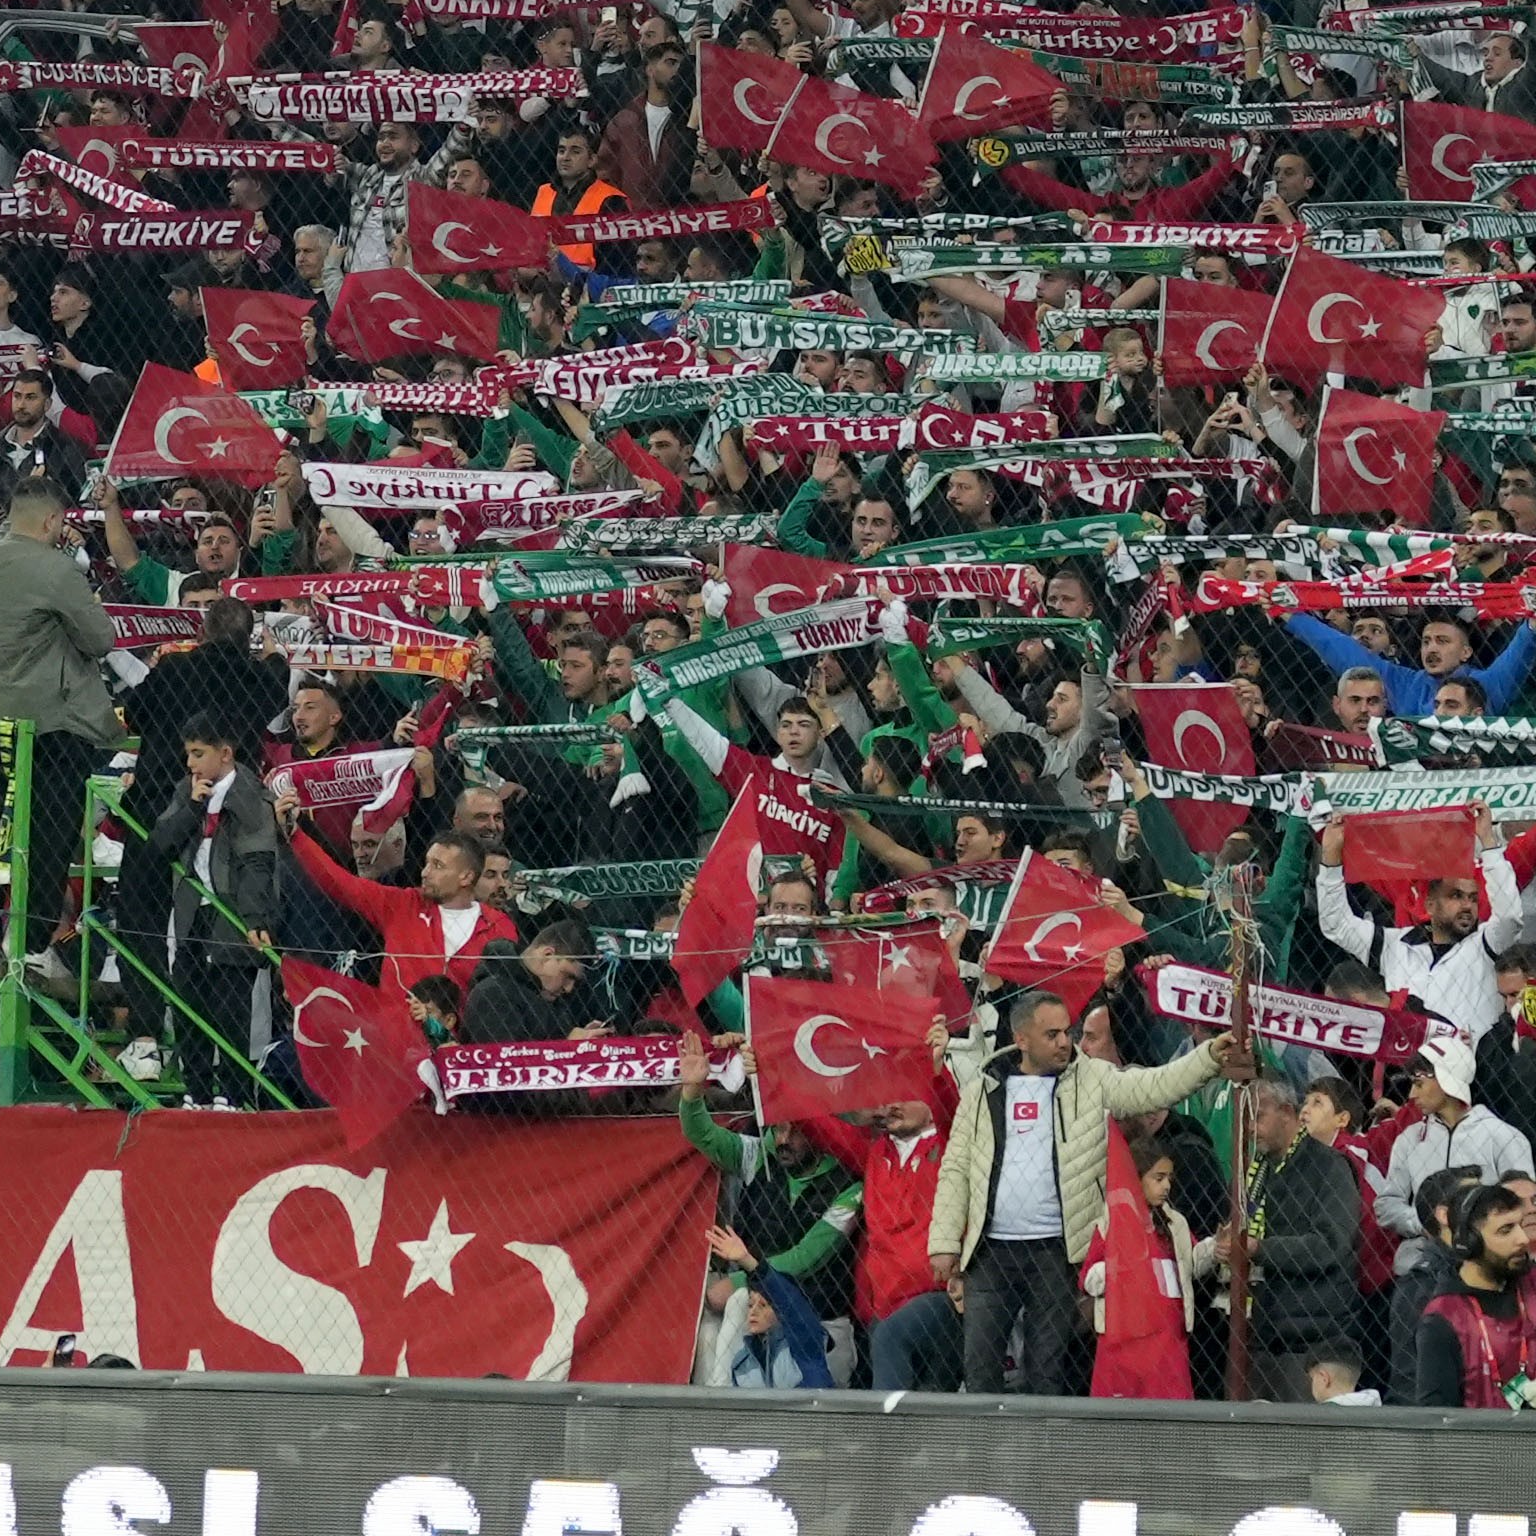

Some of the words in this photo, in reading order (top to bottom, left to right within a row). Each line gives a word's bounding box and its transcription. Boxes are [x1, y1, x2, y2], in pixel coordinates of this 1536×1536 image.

[145, 147, 308, 169] TÜRKİYE
[1015, 138, 1105, 155] BURSASPOR
[102, 219, 237, 245] TÜRKİYE
[575, 209, 729, 243] TÜRKİYE
[1122, 225, 1268, 245] TÜRKİYE
[794, 614, 863, 648] TÜRKİYE
[758, 795, 832, 842] TÜRKİYE
[1200, 977, 1233, 995] KURBA
[1171, 986, 1369, 1049] TÜKİYE
